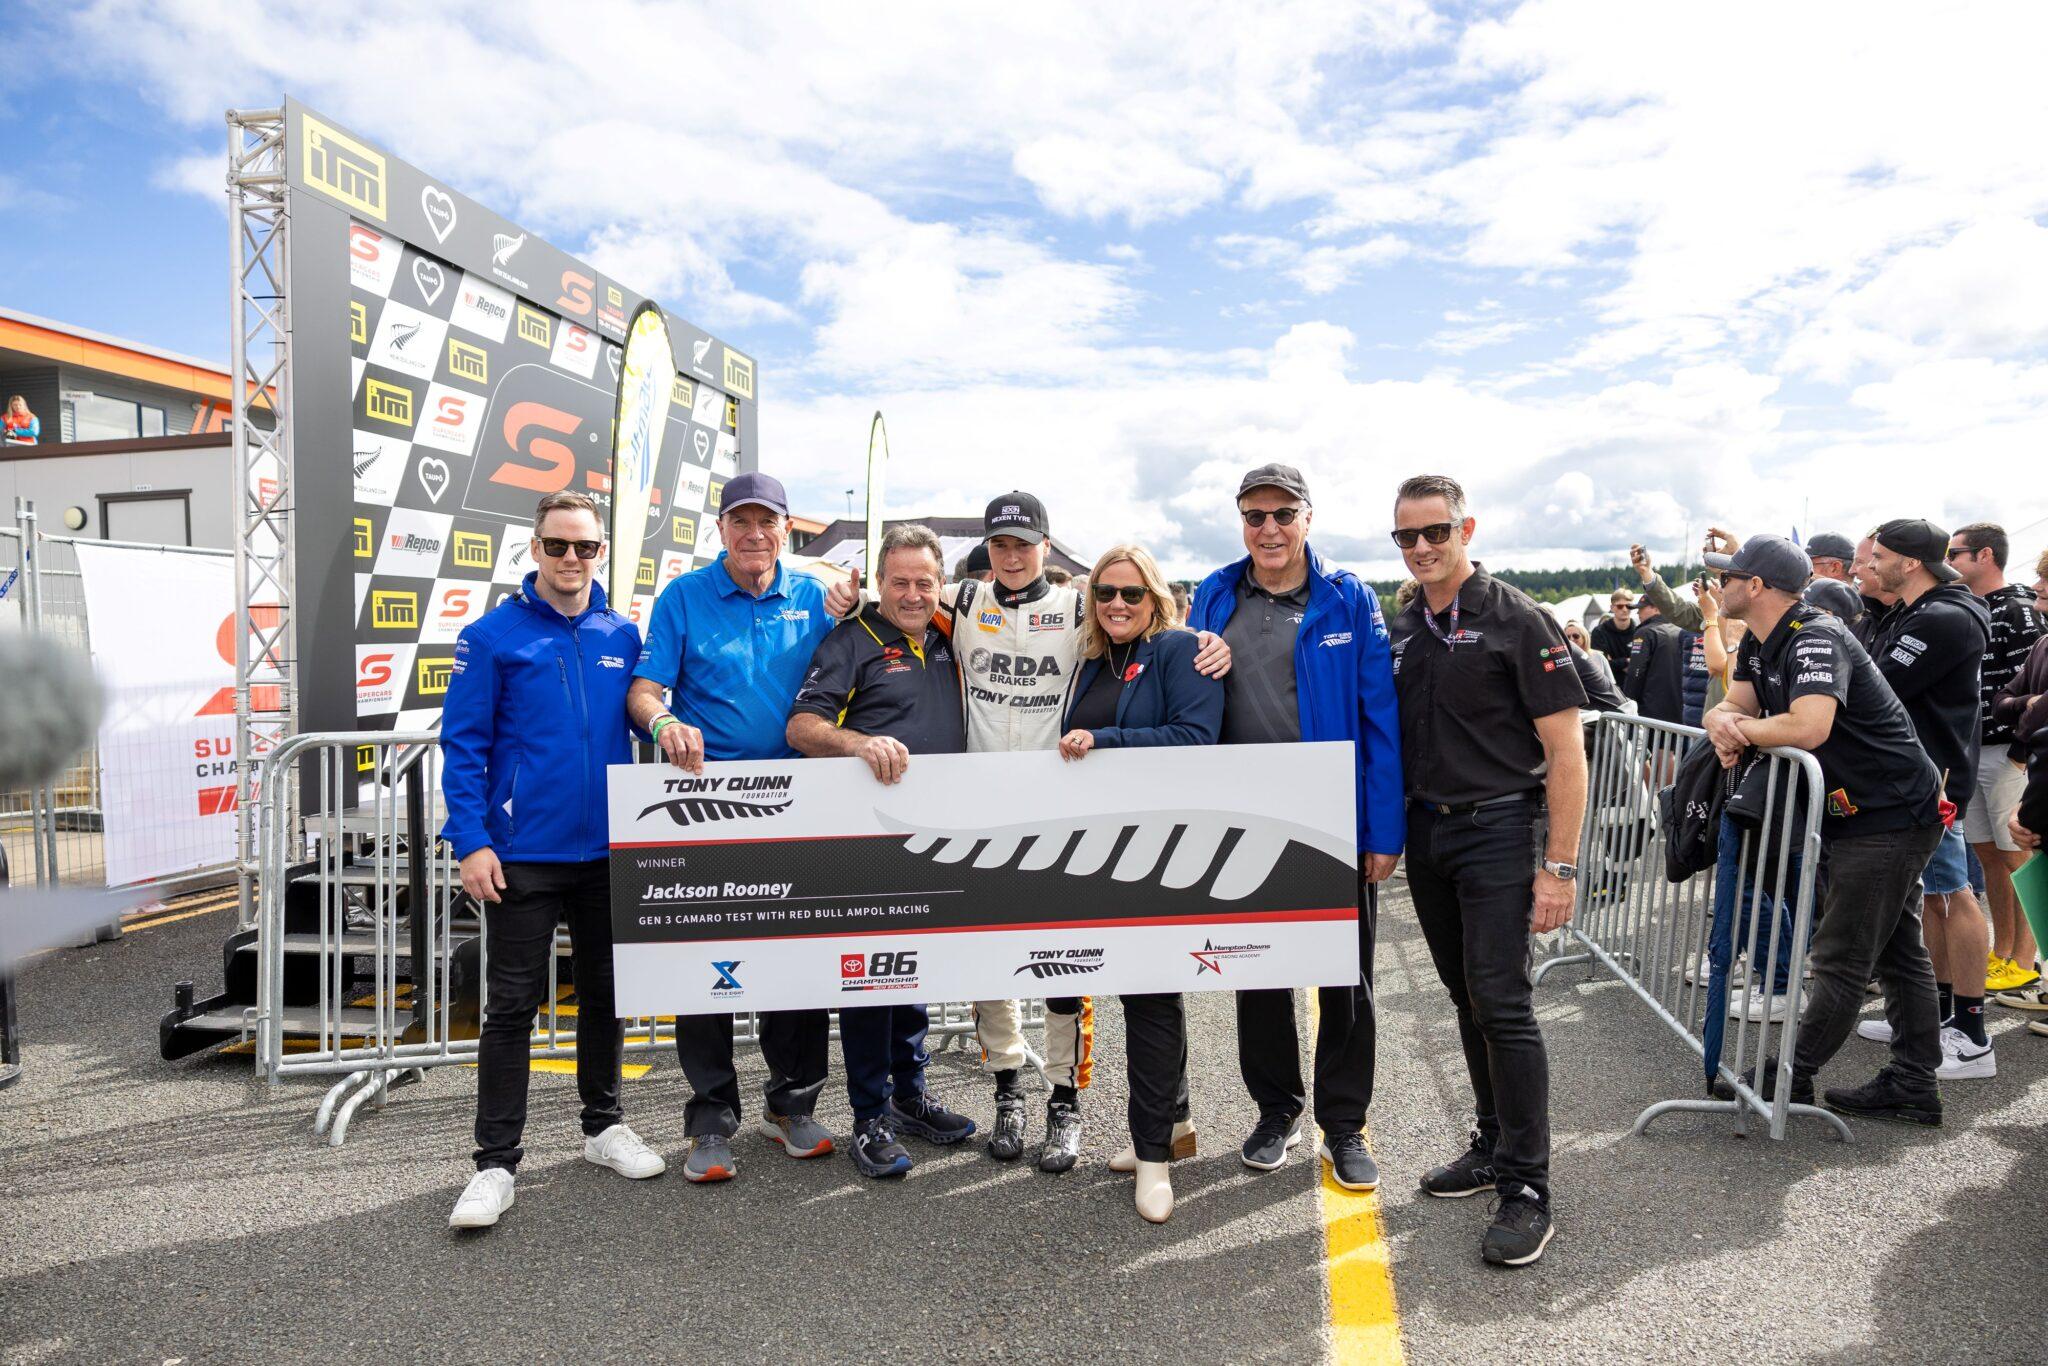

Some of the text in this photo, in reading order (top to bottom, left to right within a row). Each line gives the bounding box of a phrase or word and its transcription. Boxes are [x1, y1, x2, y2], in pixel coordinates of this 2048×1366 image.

[476, 296, 506, 320] Repco
[992, 514, 1031, 524] NEXEN TYRE
[404, 533, 440, 555] Repco
[980, 612, 1002, 626] NAPA
[1041, 612, 1064, 625] 86
[2022, 607, 2035, 627] BOSS
[990, 652, 1061, 677] RDA
[989, 674, 1037, 687] BRAKES
[357, 696, 392, 704] HAMPIONSHIP
[969, 686, 1061, 708] TONY QUINN
[663, 775, 793, 794] TONY QUINN
[741, 791, 788, 800] FOUNDATION
[637, 857, 687, 869] WINNER
[642, 880, 793, 900] Jackson Rooney
[638, 904, 930, 926] GEN 3 CAMARO TEST WITH RED BULL AMPOL RACING
[1029, 948, 1104, 960] TONY QUINN
[869, 951, 918, 977] 86
[842, 977, 919, 986] CHAMPIONSHIP
